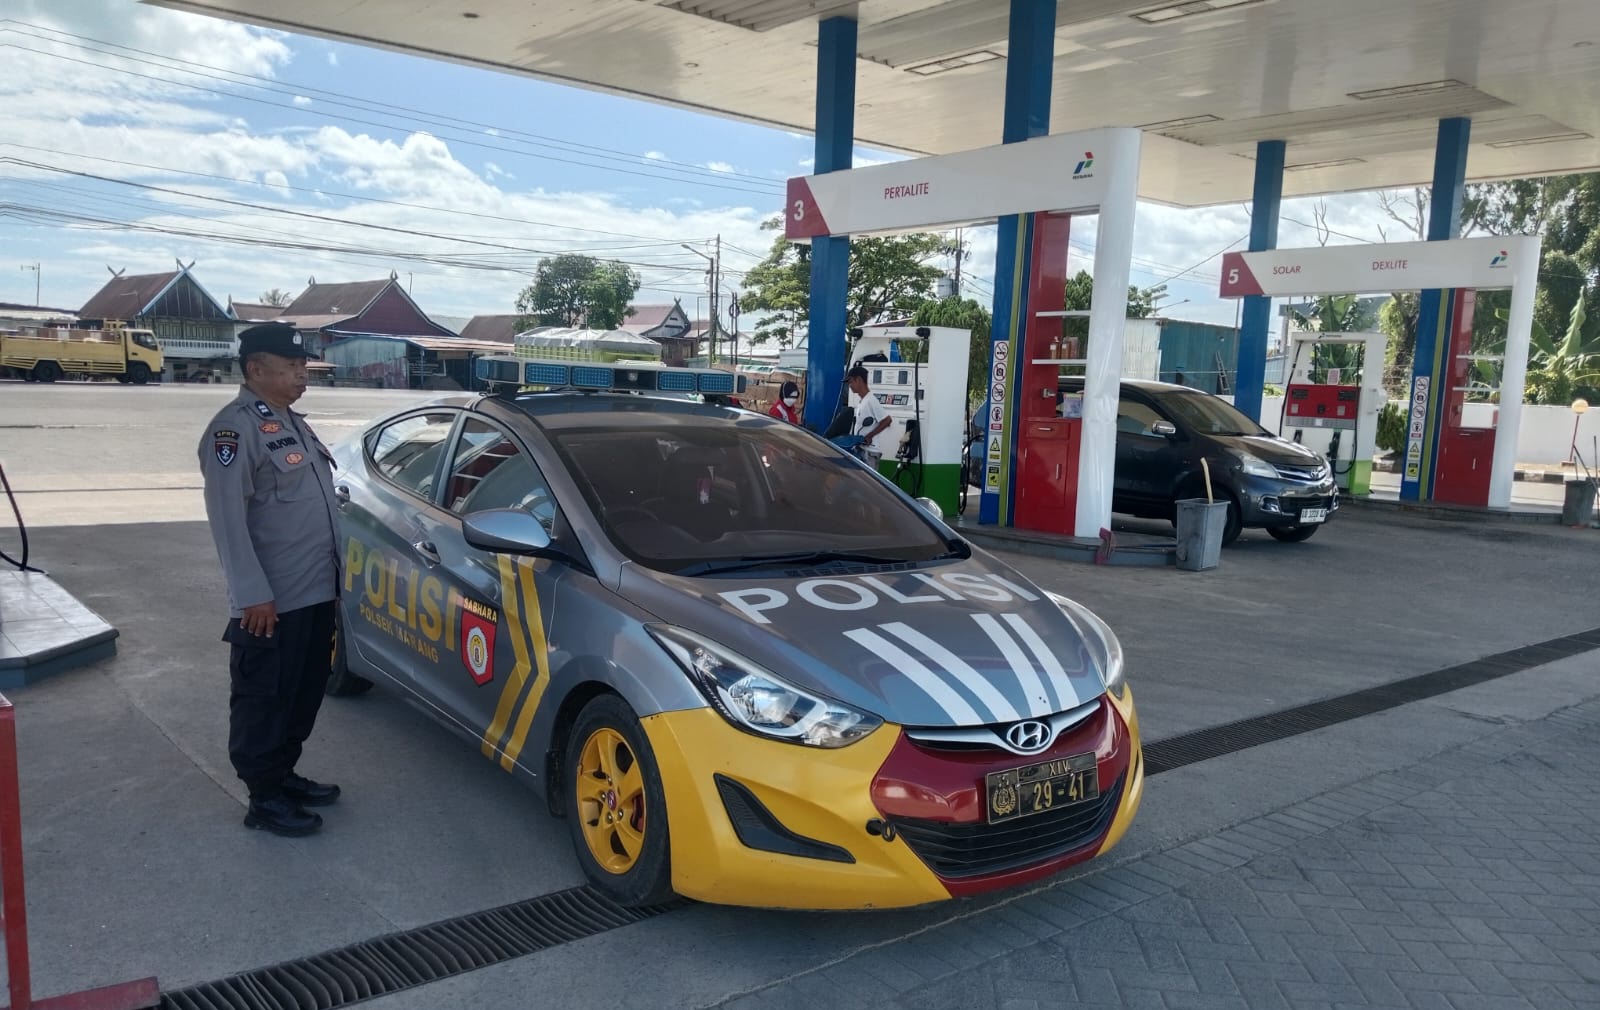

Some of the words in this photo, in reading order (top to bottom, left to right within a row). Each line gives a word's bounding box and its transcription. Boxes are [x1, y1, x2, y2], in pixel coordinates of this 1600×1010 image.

[883, 182, 930, 200] PERTALITE
[793, 199, 805, 221] 3
[1227, 268, 1240, 285] 5
[1272, 265, 1302, 276] SOLAR
[1372, 260, 1409, 271] DEXLITE
[344, 536, 458, 652] POLISI
[717, 573, 1041, 624] POLISI
[360, 602, 394, 637] POLSEK
[463, 597, 497, 623] SABHARA
[1049, 759, 1071, 777] XIV
